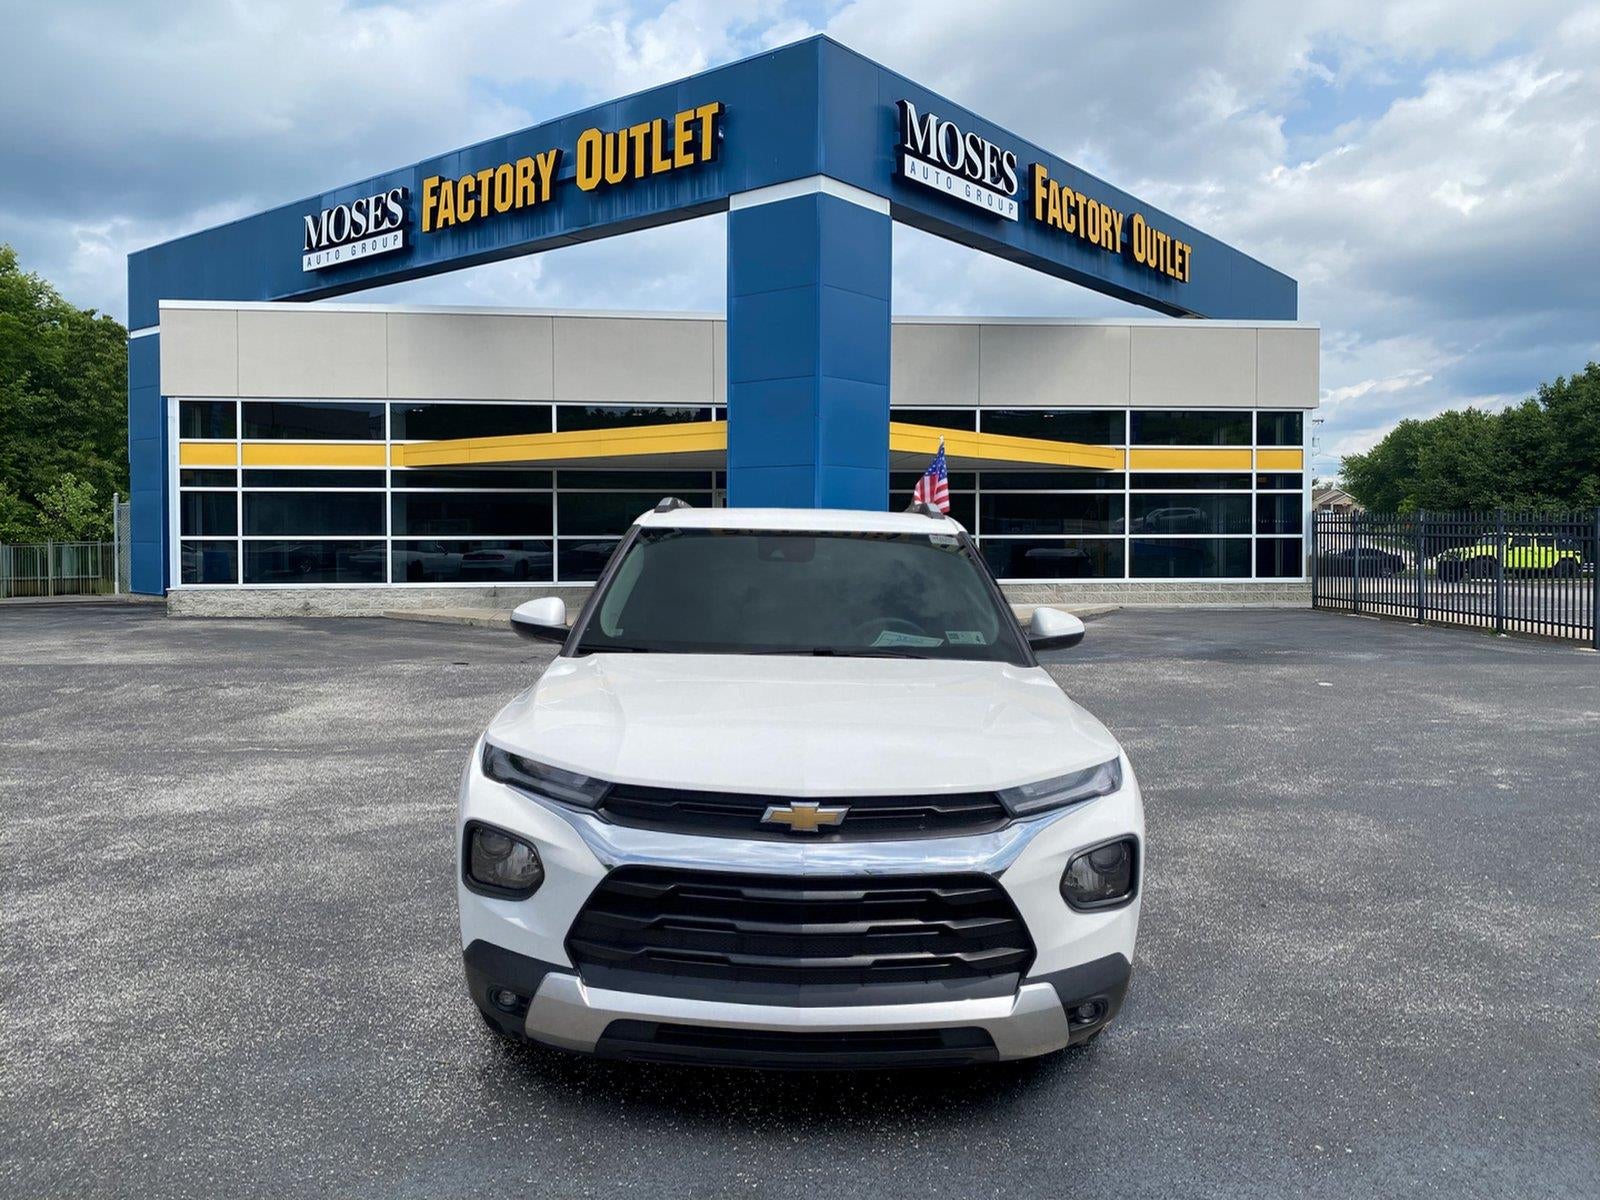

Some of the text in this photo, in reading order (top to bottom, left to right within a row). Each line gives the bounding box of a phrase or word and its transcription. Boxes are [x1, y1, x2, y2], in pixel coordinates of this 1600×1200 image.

[422, 102, 720, 232] FACTORY OUTLET
[904, 100, 1018, 195] MOSES
[303, 187, 403, 251] MOSES
[910, 161, 1014, 214] AUTO GROUP
[1034, 163, 1192, 283] FACTORY OUTLET
[307, 234, 399, 267] AUTO GROUP
